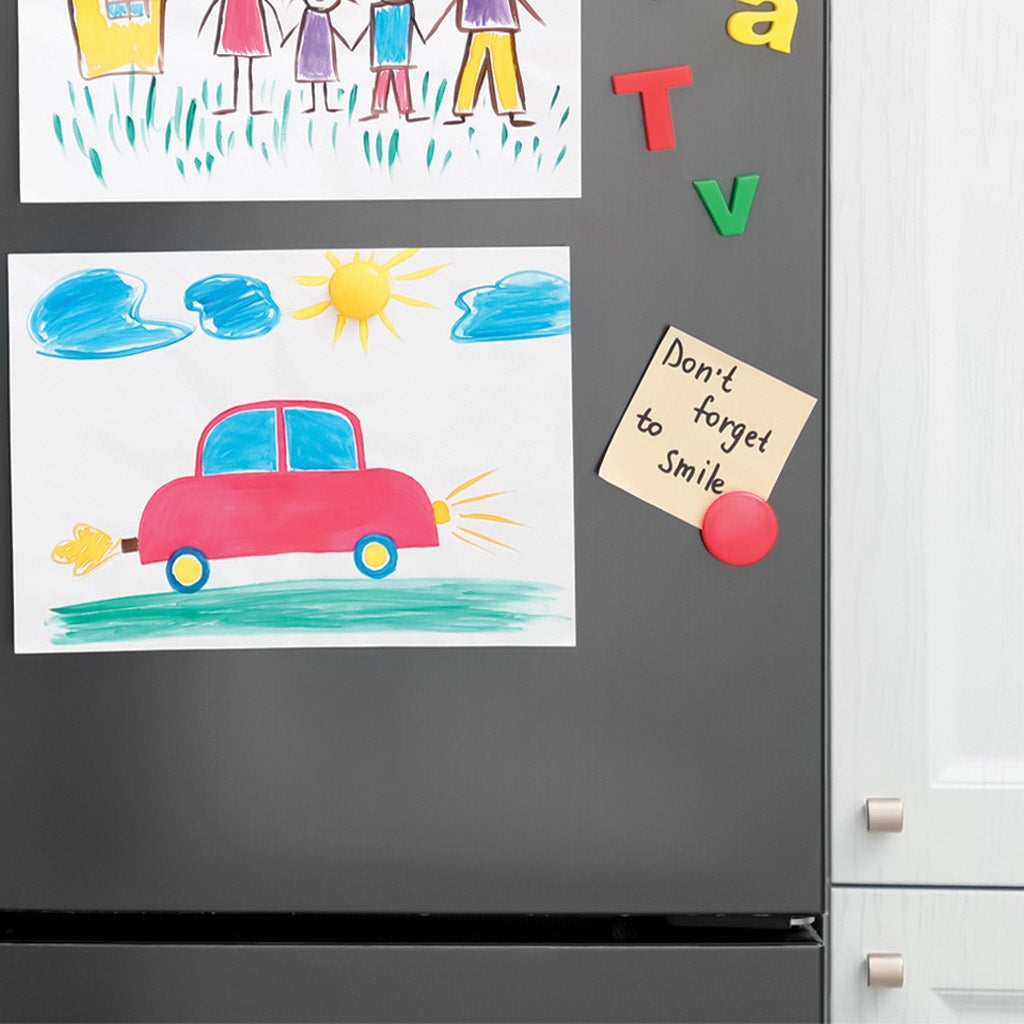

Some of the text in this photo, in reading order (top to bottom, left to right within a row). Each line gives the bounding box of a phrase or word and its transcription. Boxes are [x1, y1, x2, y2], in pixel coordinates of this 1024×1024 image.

[610, 64, 693, 152] T
[661, 337, 738, 393] Don't
[636, 407, 663, 437] to
[693, 394, 773, 454] forget
